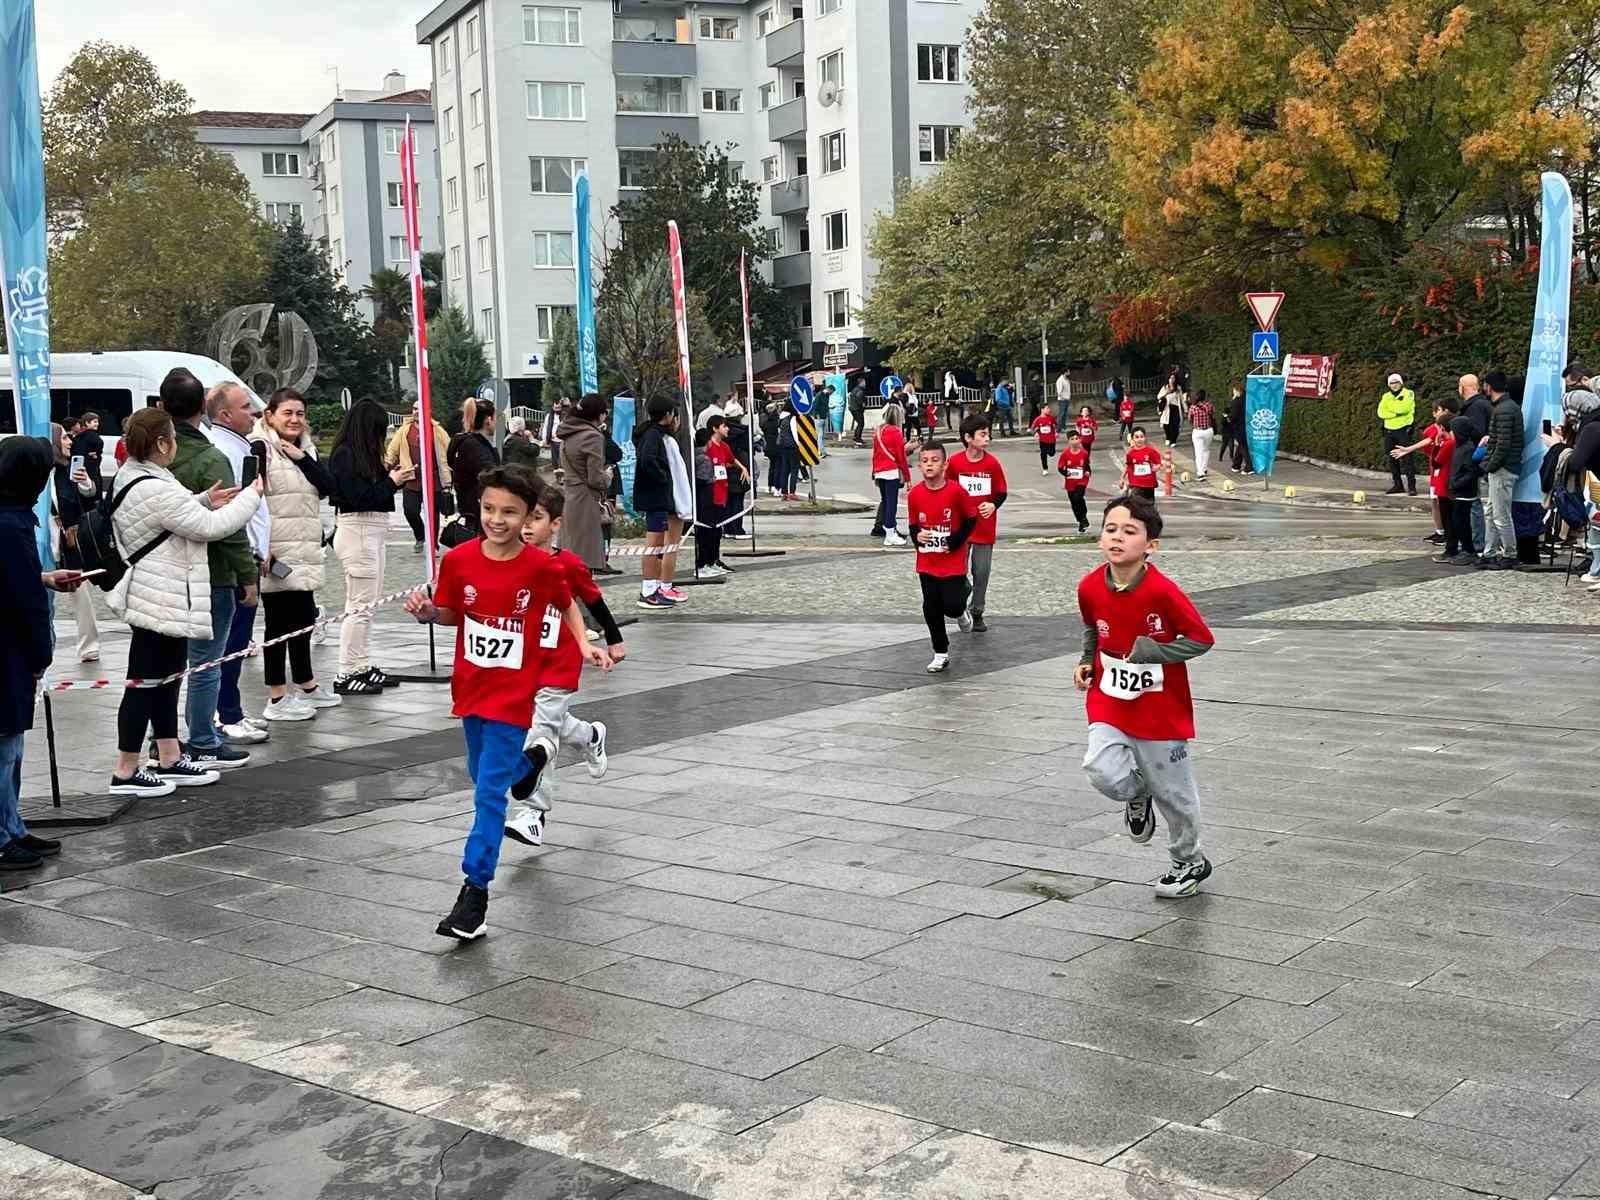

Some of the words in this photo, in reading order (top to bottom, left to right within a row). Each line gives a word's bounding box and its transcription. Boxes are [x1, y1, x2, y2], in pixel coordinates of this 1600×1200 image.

[967, 483, 982, 491] 210
[927, 536, 947, 548] 536
[541, 622, 551, 639] 9
[468, 633, 514, 659] 1527
[1111, 667, 1154, 692] 1526
